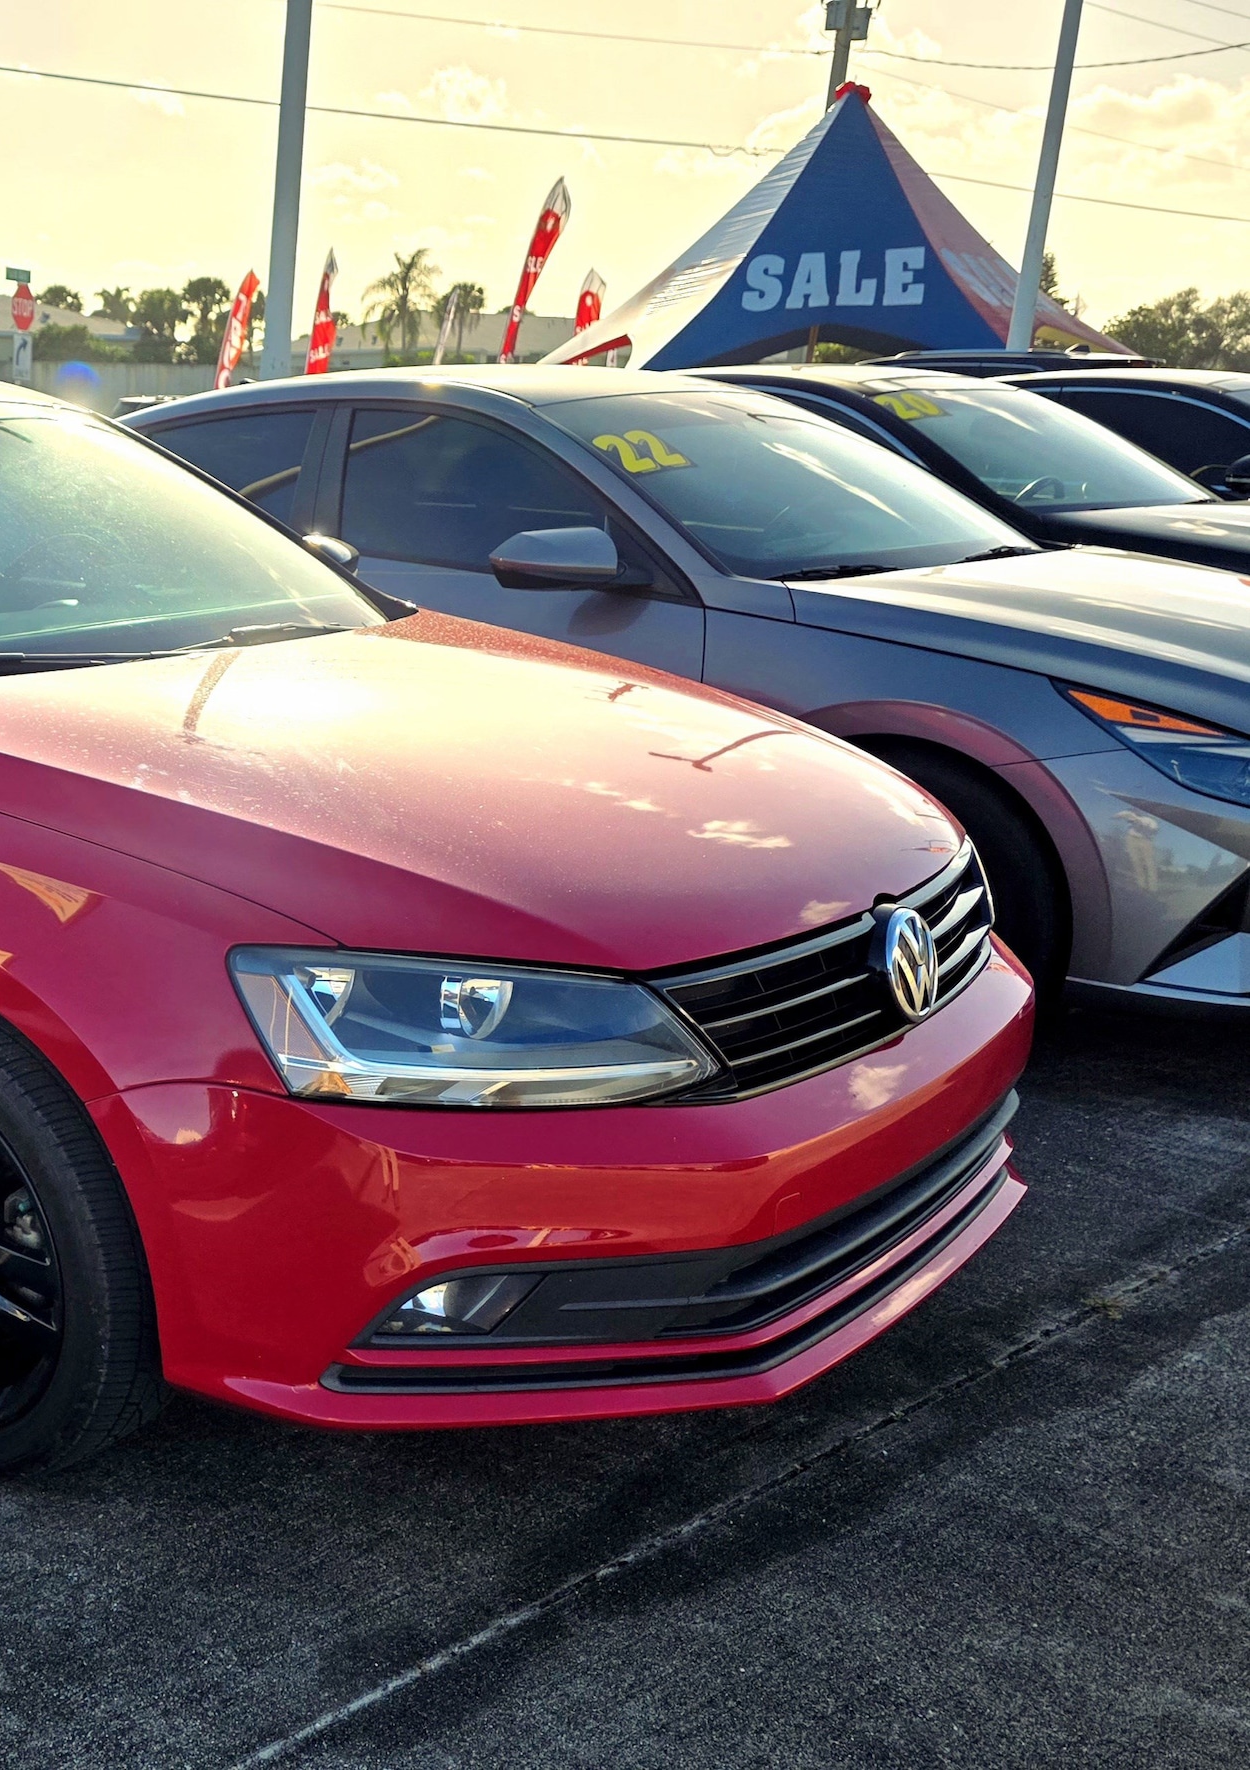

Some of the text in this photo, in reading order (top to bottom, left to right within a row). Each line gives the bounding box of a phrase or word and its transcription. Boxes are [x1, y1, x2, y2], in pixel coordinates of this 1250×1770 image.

[741, 246, 926, 312] SALE
[13, 298, 34, 316] STOP
[874, 393, 942, 421] 20
[592, 430, 690, 474] 22
